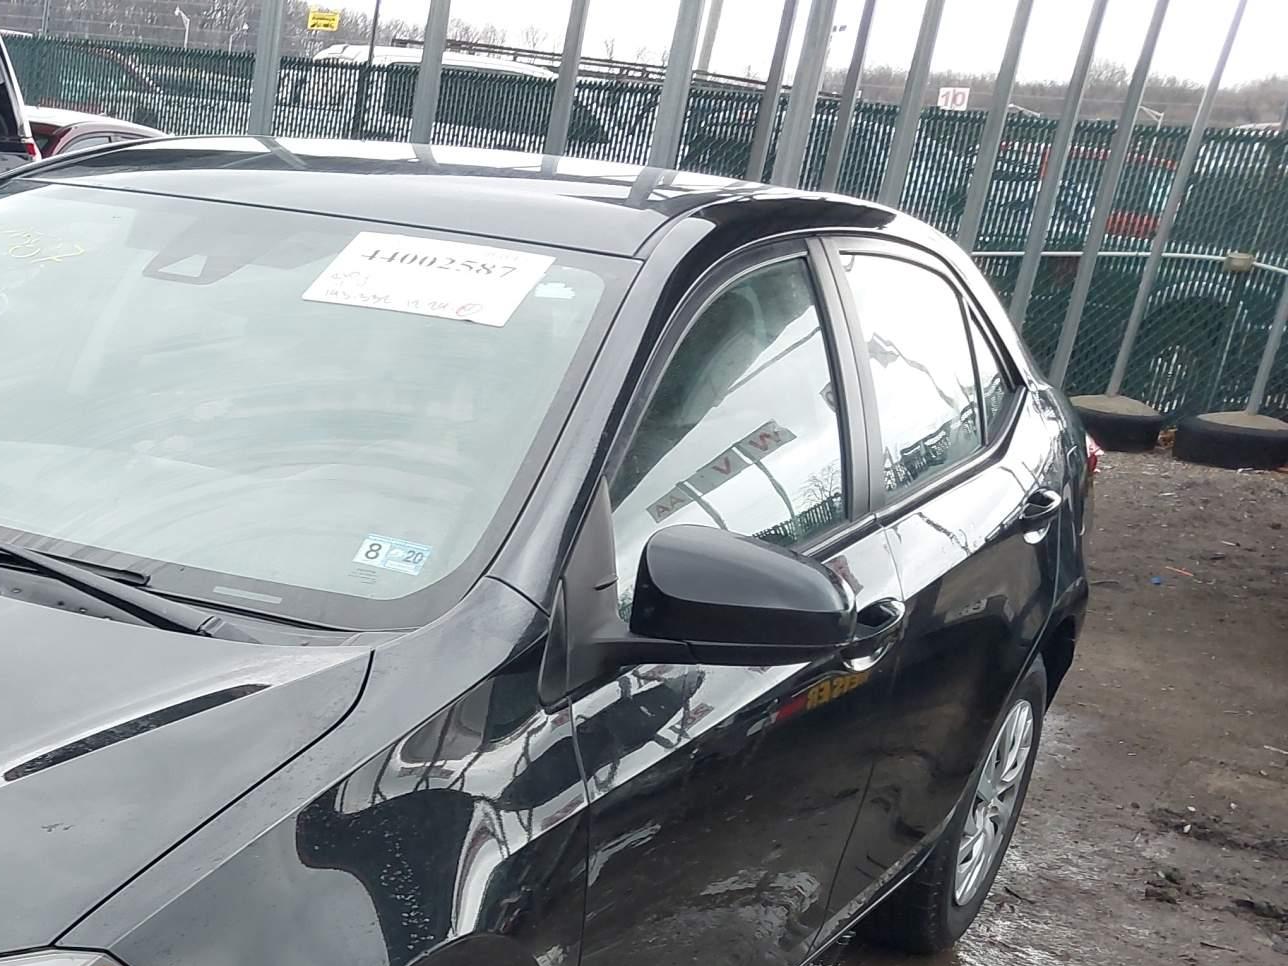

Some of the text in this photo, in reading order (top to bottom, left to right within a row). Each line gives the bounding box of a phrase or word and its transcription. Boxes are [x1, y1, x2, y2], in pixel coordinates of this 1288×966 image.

[940, 90, 966, 107] 10
[359, 248, 518, 279] 44002587
[365, 543, 424, 564] 8 20
